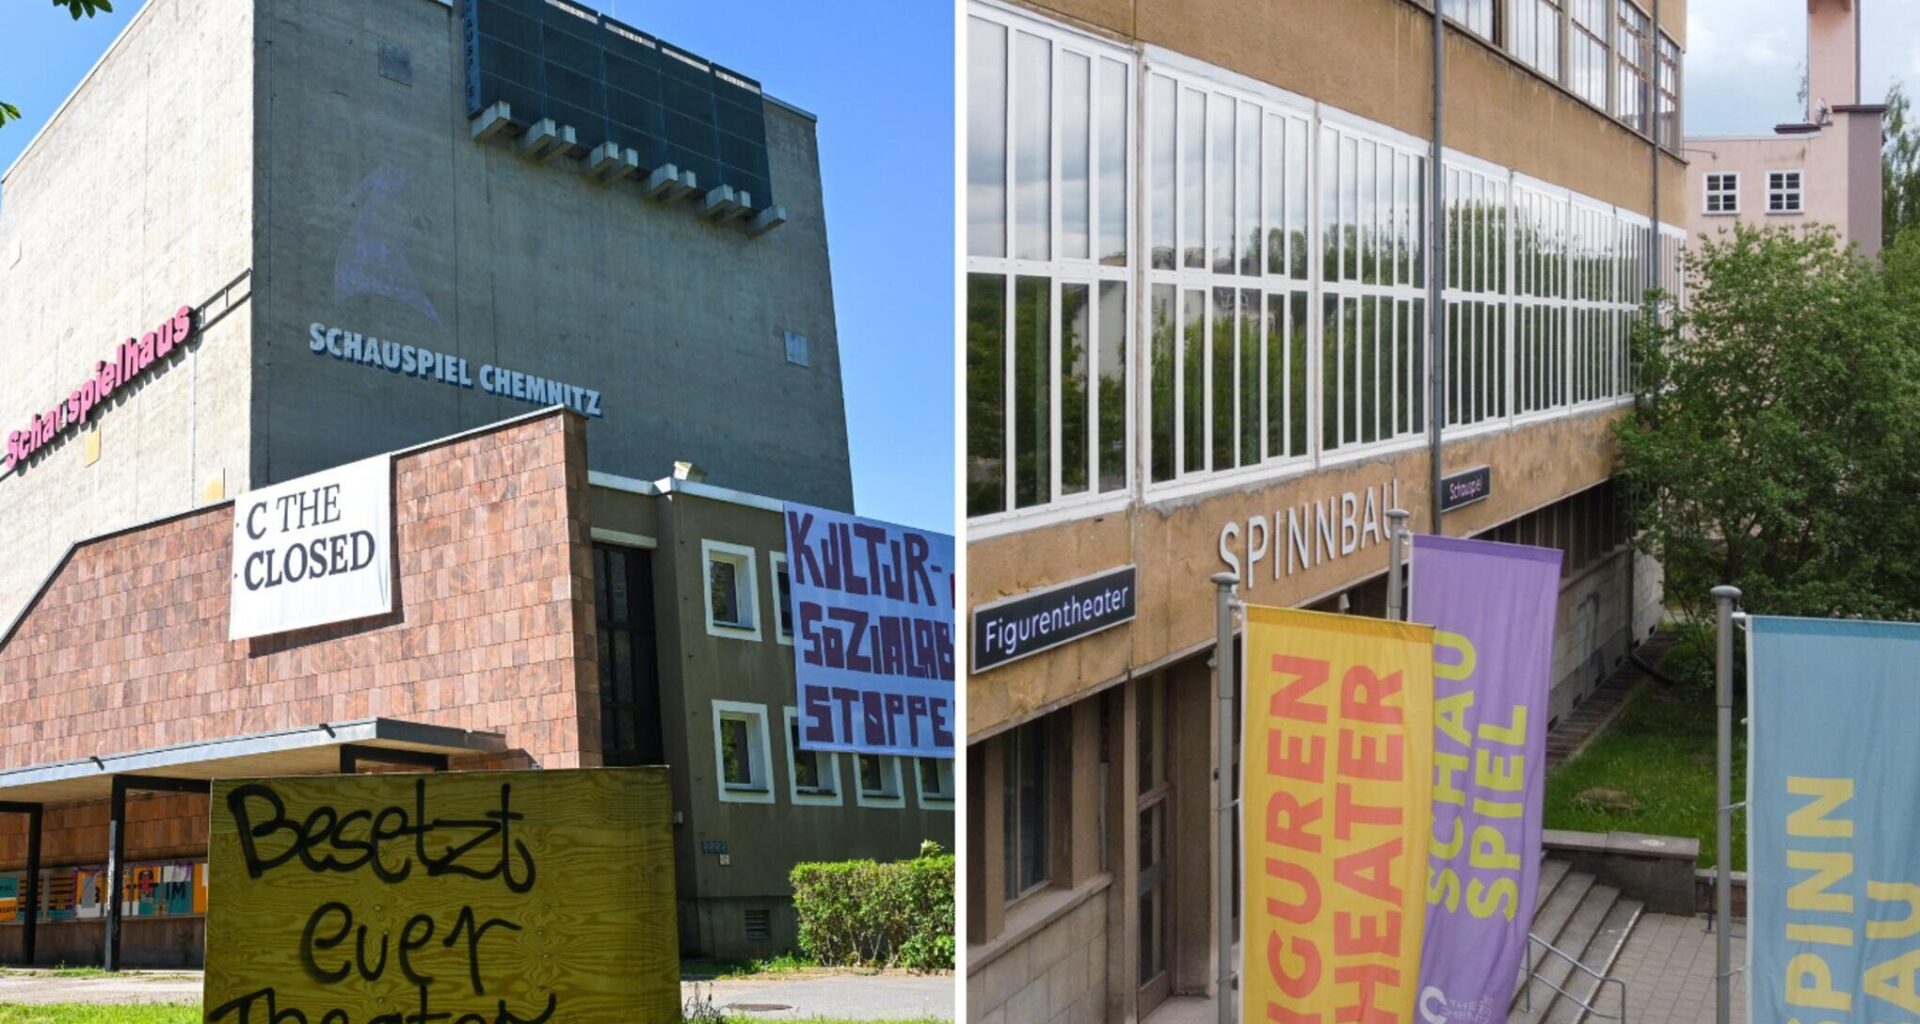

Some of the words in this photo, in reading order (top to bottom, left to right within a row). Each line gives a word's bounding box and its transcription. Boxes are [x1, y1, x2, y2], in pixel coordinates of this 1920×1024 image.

[6, 305, 190, 468] Schauspielhaus
[309, 323, 472, 386] SCHAUSPIEL
[479, 363, 602, 417] CHEMNITZ
[244, 530, 375, 591] CLOSED
[246, 502, 267, 540] C
[276, 484, 341, 533] THE
[1219, 478, 1398, 594] SPINNBAU
[984, 583, 1129, 655] Figurentheater
[805, 684, 955, 748] STOPPE
[1426, 630, 1477, 913] SCHAU
[228, 778, 536, 893] Besetzt
[1466, 704, 1528, 924] SPIEL
[301, 901, 522, 996] euer
[1785, 775, 1855, 1024] PINN
[1863, 880, 1920, 1024] AU
